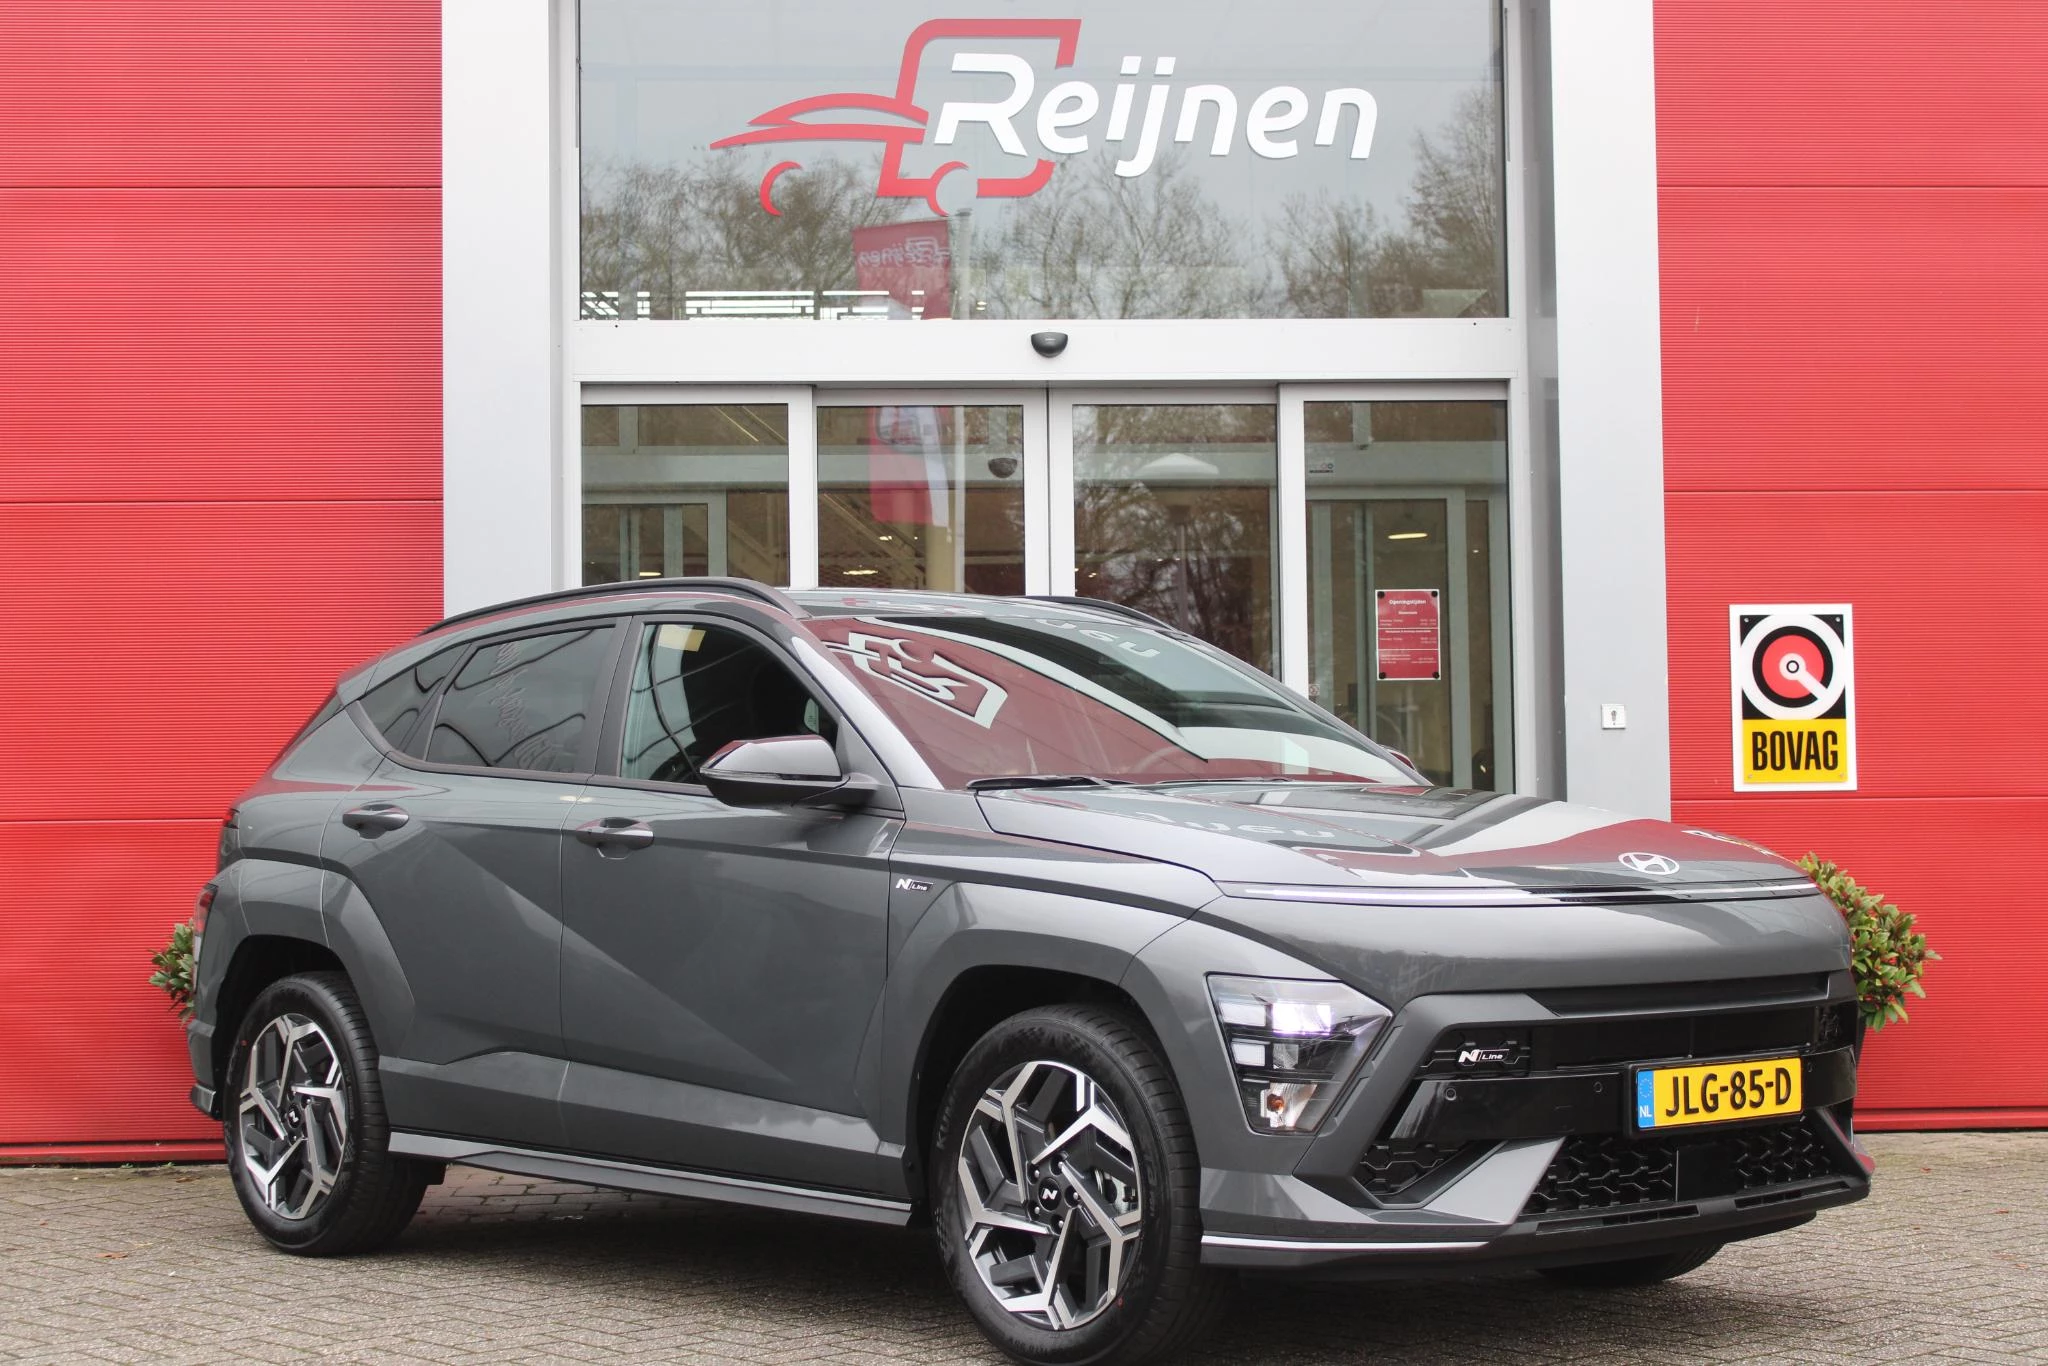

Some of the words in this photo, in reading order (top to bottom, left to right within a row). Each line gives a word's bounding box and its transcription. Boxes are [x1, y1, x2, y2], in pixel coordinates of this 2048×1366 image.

[934, 53, 1378, 178] Reijnen
[1752, 730, 1839, 771] BOVAG
[1458, 1049, 1481, 1063] N
[1665, 1067, 1792, 1117] JLG-85-D
[1639, 1104, 1653, 1118] NL
[1042, 1187, 1058, 1200] N
